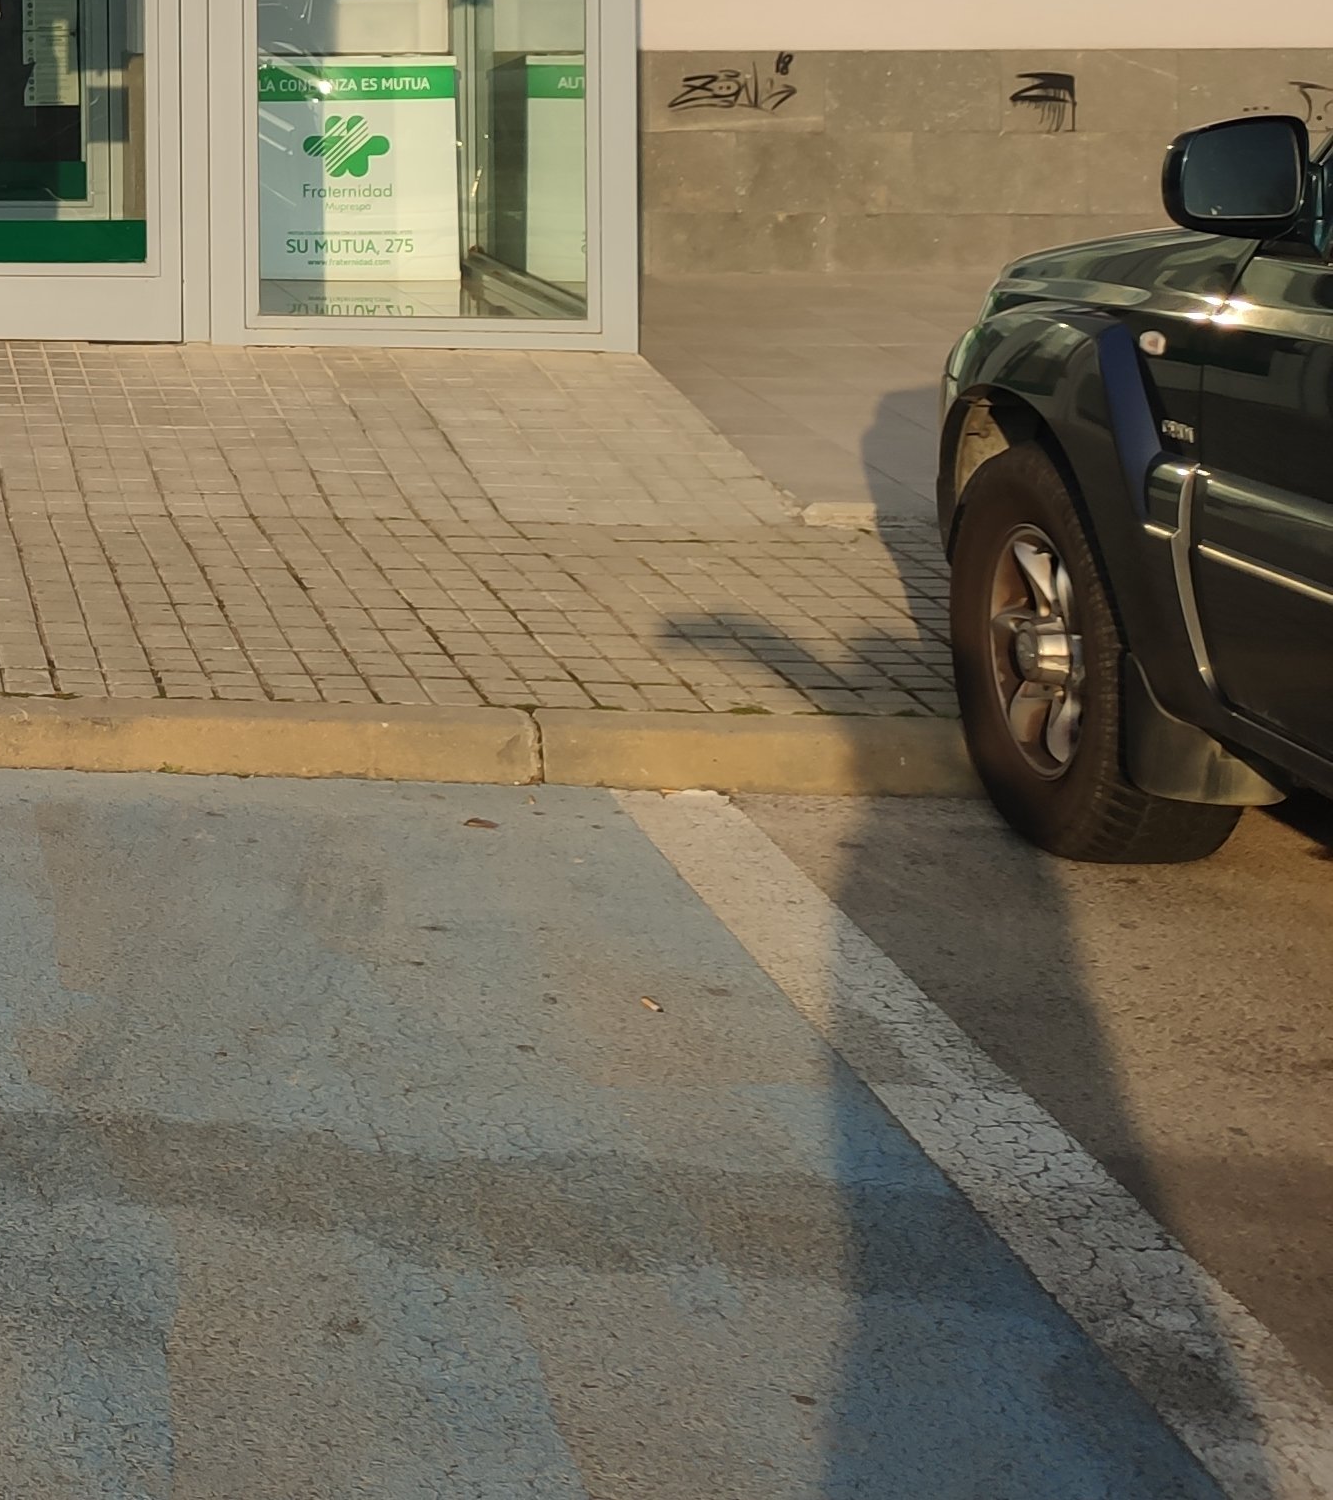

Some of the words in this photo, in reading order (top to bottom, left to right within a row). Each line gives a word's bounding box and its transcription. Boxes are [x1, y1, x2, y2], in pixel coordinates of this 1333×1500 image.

[258, 79, 276, 92] LA
[361, 78, 378, 90] ES
[381, 77, 431, 90] MUTUA
[302, 183, 393, 198] Fraternidad
[325, 202, 371, 212] Muprespa
[286, 238, 309, 254] SU
[314, 238, 380, 255] MUTUA,
[385, 238, 414, 253] 275
